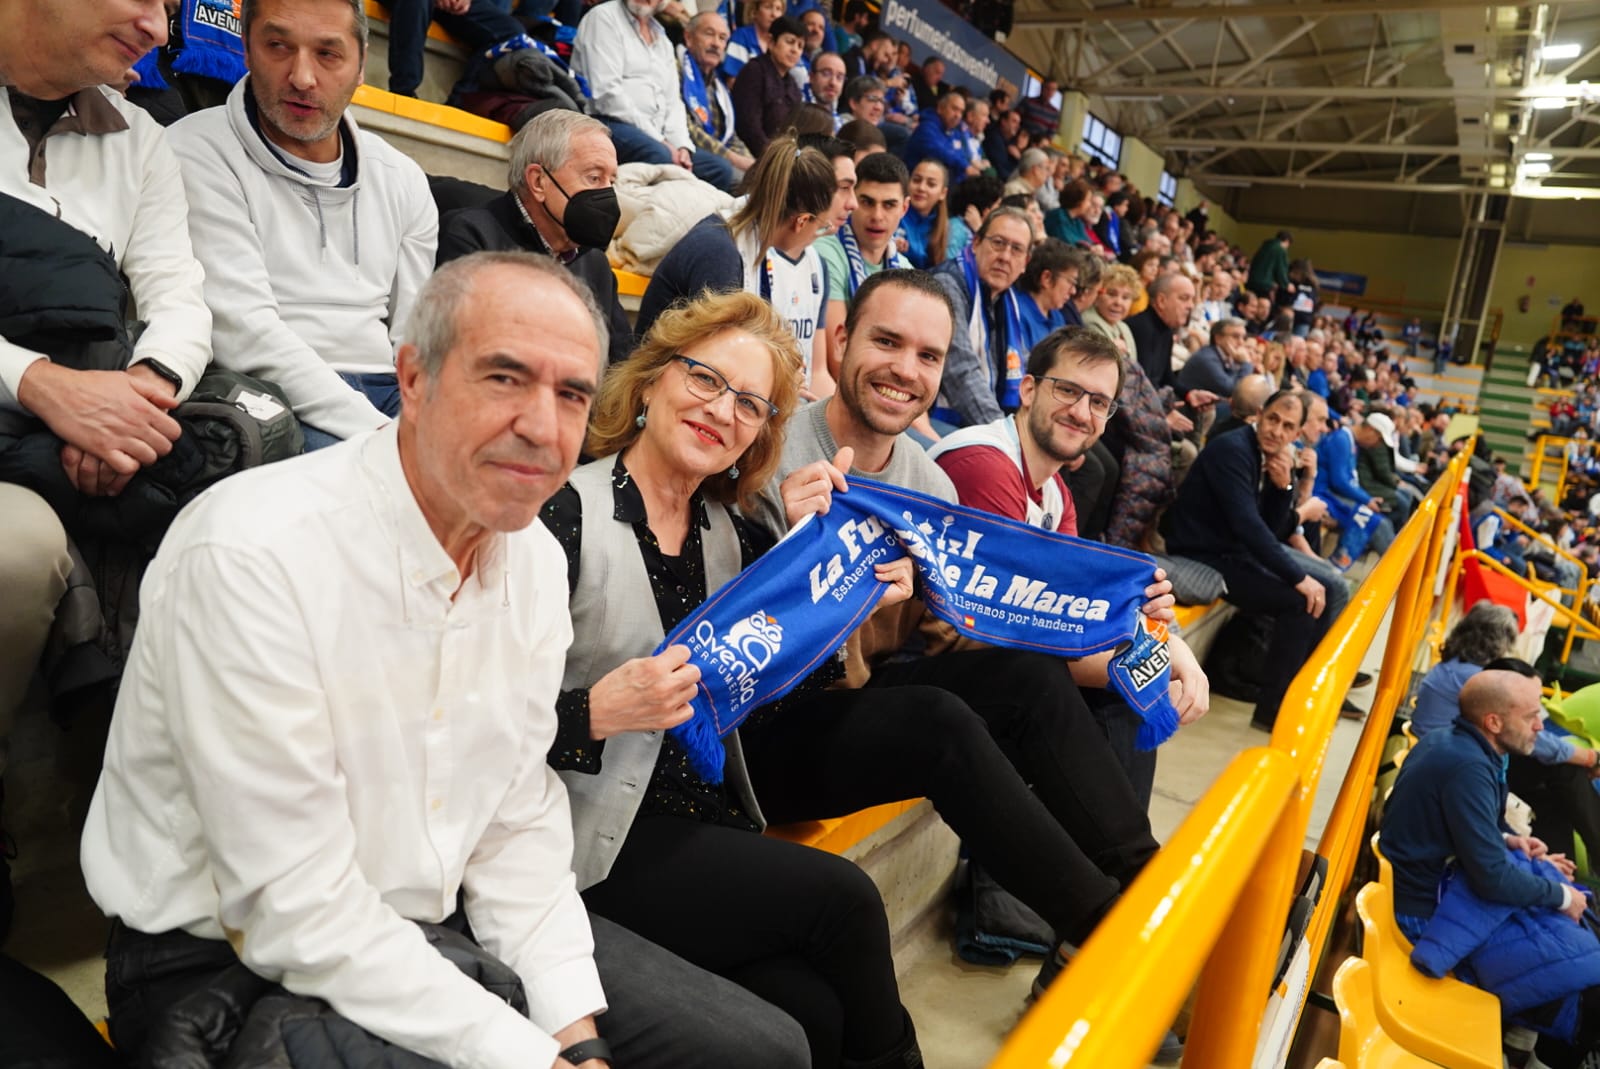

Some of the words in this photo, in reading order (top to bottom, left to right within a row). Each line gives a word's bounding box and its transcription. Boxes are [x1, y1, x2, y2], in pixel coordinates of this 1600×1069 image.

[198, 5, 242, 34] AVENI
[809, 553, 844, 605] La
[963, 564, 999, 599] la
[1000, 574, 1110, 622] Marea
[832, 547, 887, 602] Esfuerzo,
[1007, 611, 1030, 624] por
[1032, 614, 1085, 634] bandera
